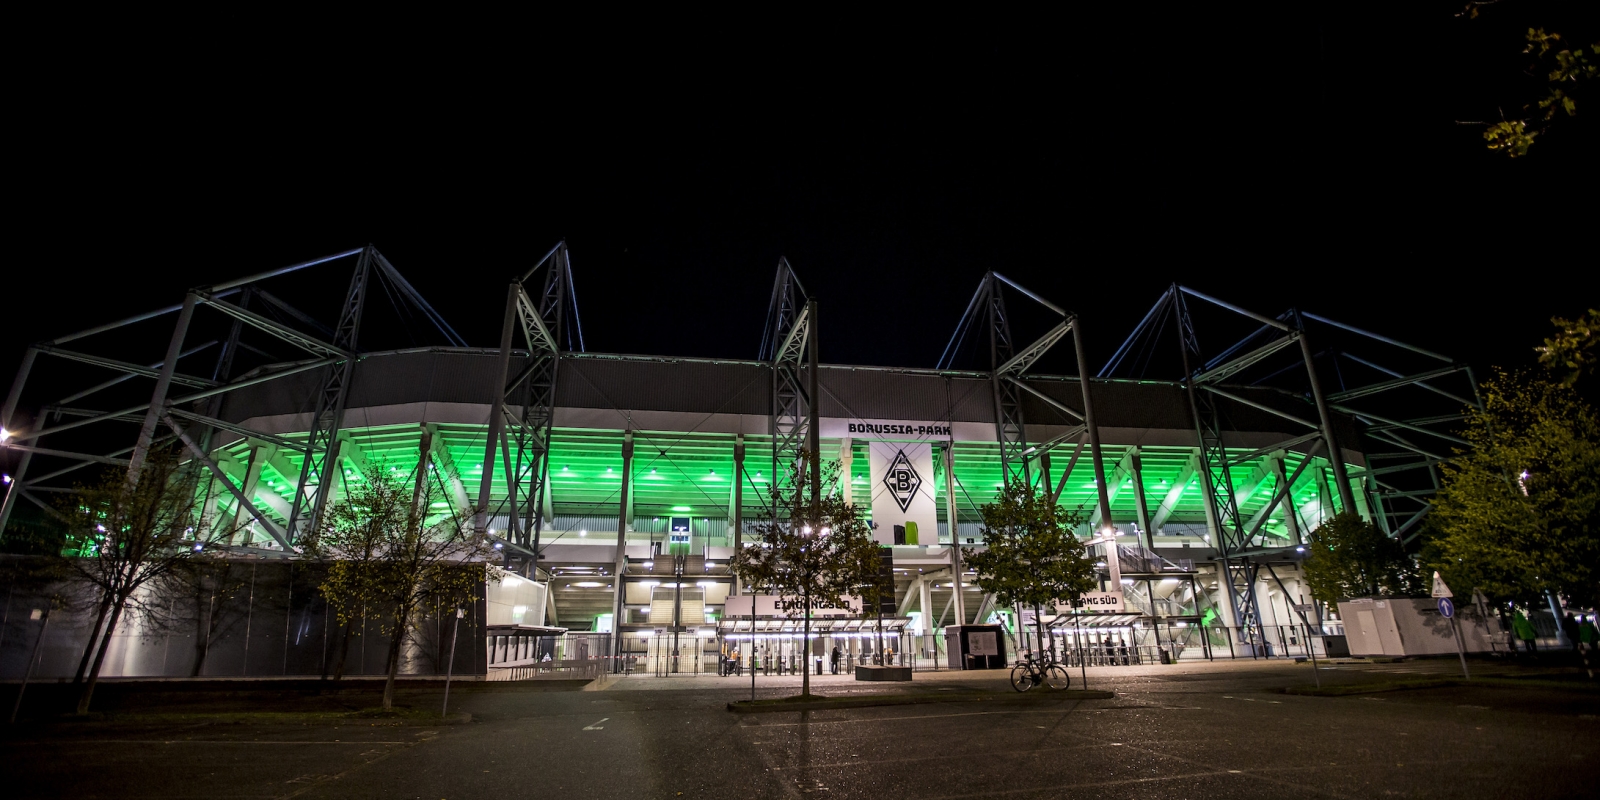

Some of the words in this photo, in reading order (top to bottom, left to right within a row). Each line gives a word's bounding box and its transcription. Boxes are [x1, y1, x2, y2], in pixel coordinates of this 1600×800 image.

[848, 423, 951, 435] BORUSSIA-PARK
[896, 470, 911, 492] B
[1059, 597, 1098, 605] EIANG
[1100, 595, 1117, 605] SÜD
